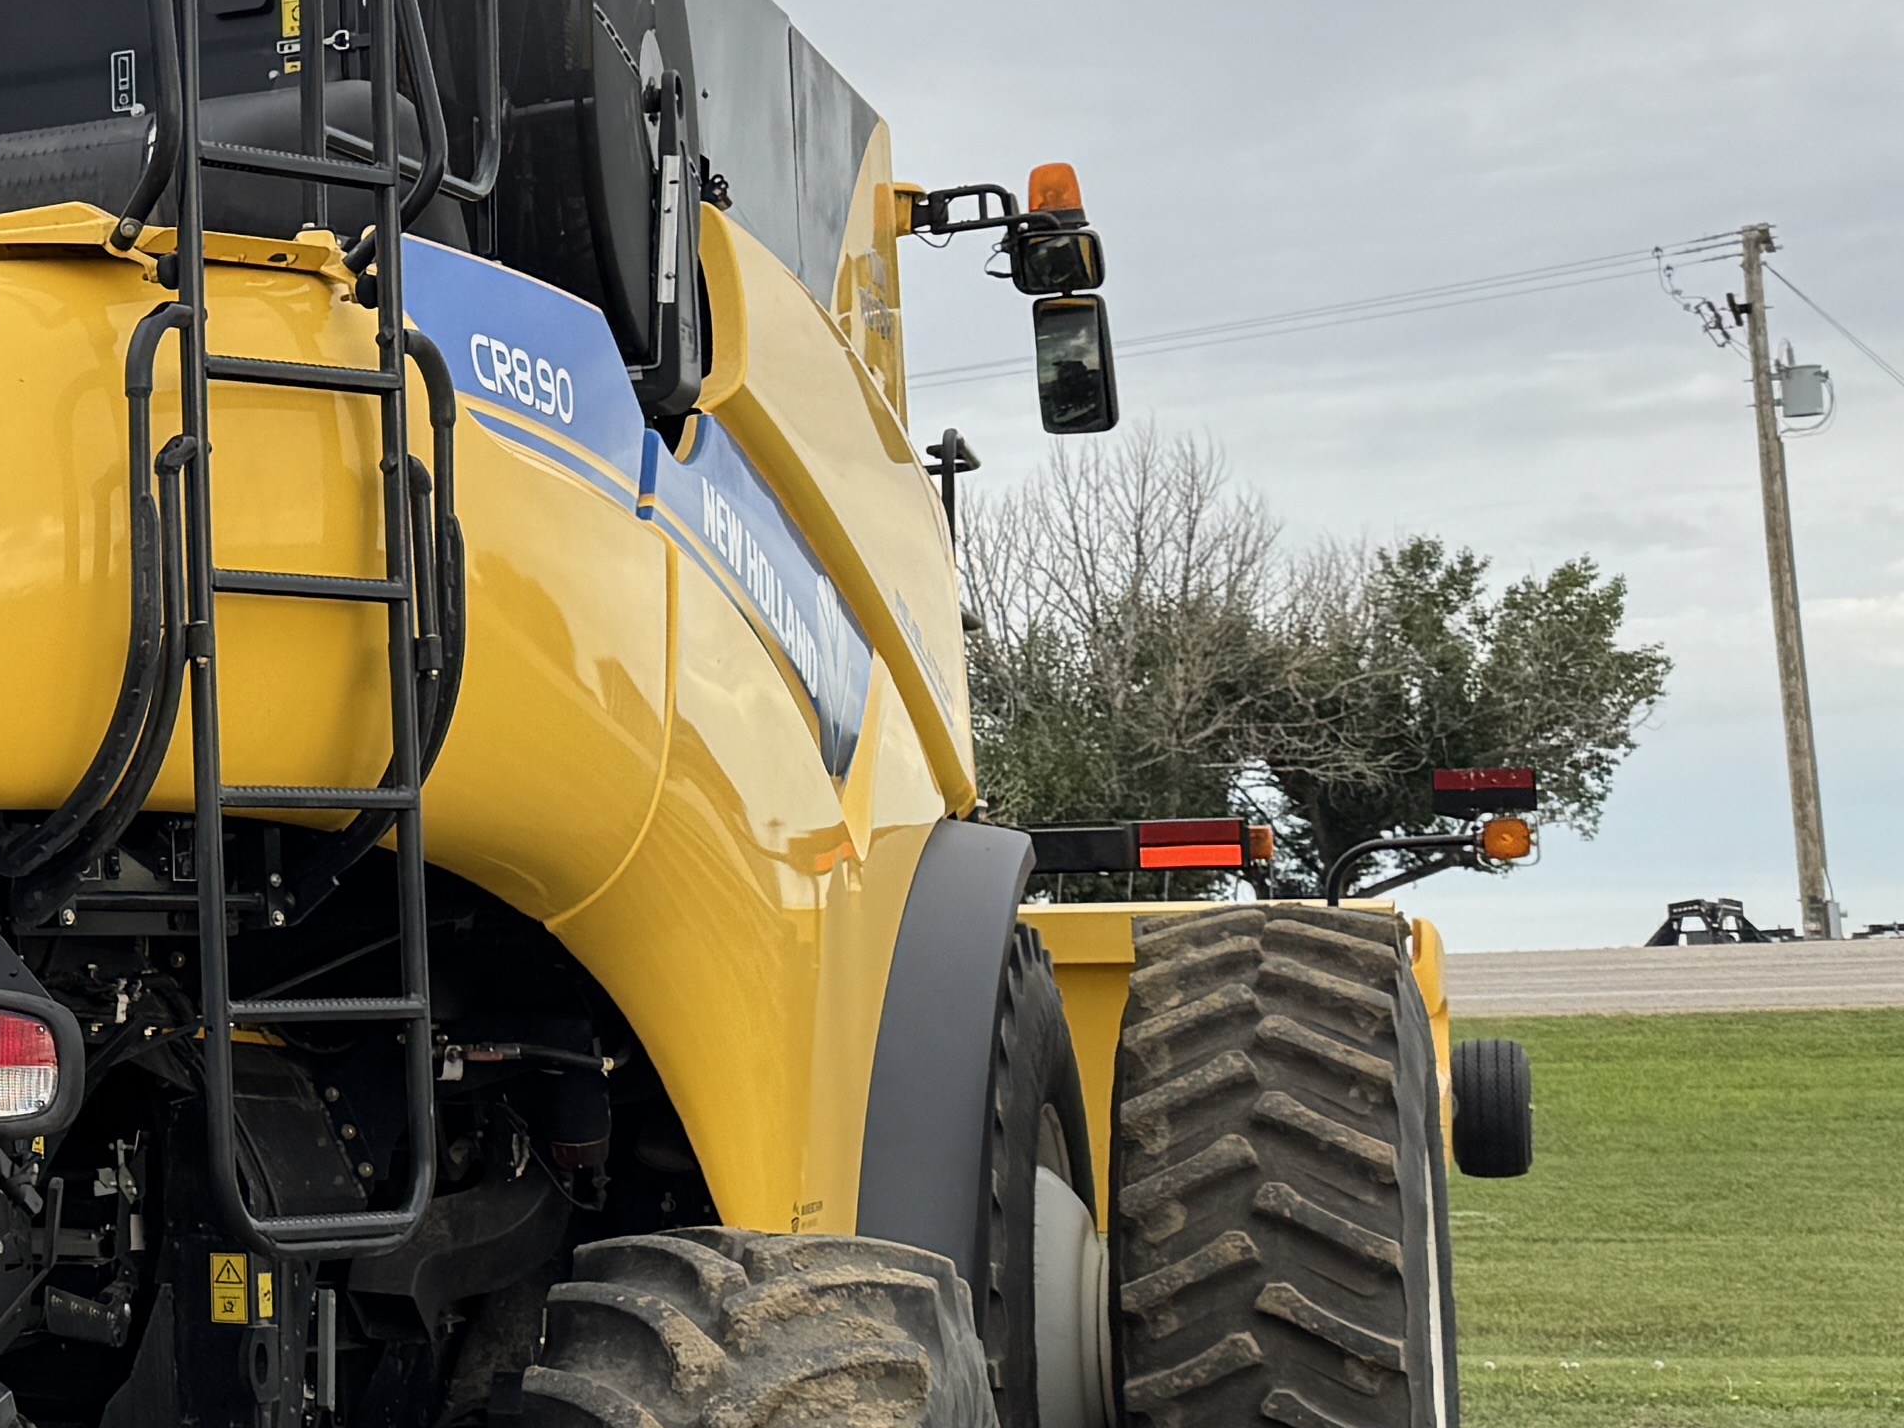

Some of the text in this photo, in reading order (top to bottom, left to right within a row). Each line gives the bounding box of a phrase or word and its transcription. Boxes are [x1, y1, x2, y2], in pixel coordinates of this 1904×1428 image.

[470, 333, 574, 424] CR8.90
[701, 475, 819, 699] NEW HOLLAND
